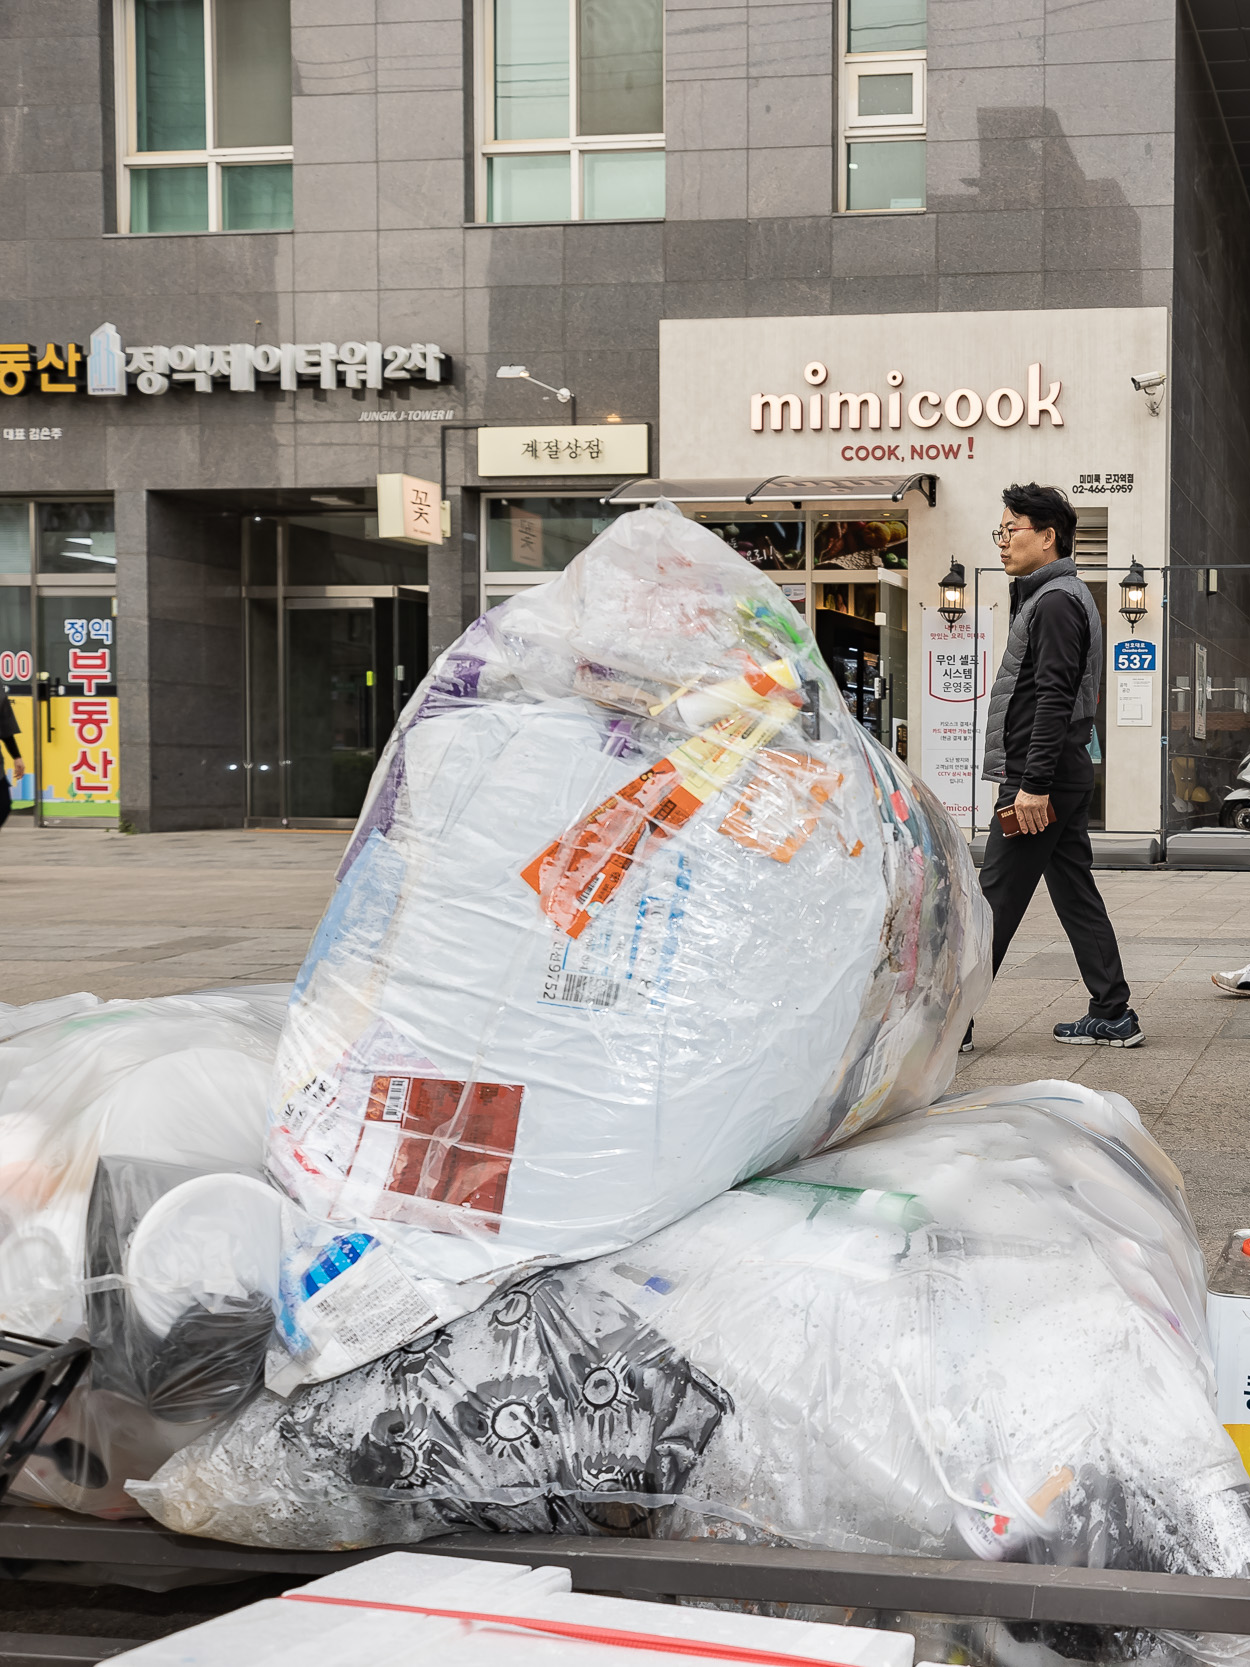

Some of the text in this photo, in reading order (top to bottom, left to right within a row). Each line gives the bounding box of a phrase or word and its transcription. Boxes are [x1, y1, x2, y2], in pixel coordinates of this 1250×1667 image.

[0, 343, 82, 396] 동산
[750, 361, 1065, 432] mimicook
[358, 411, 398, 421] JUNGIK
[399, 410, 446, 420] J-TOWER
[3, 428, 26, 440] 대표
[521, 438, 602, 460] 계절상점
[841, 445, 905, 462] COOK,
[1105, 473, 1134, 484] 군자역점
[1072, 484, 1133, 494] 02-466-6959
[410, 489, 431, 524] 꽃
[64, 619, 112, 645] 정익
[958, 624, 972, 632] 만든
[936, 654, 979, 666] 무인 셀프
[1118, 654, 1153, 669] 537
[942, 668, 973, 680] 시스템
[942, 681, 973, 693] 운영중
[68, 649, 115, 796] 부동산
